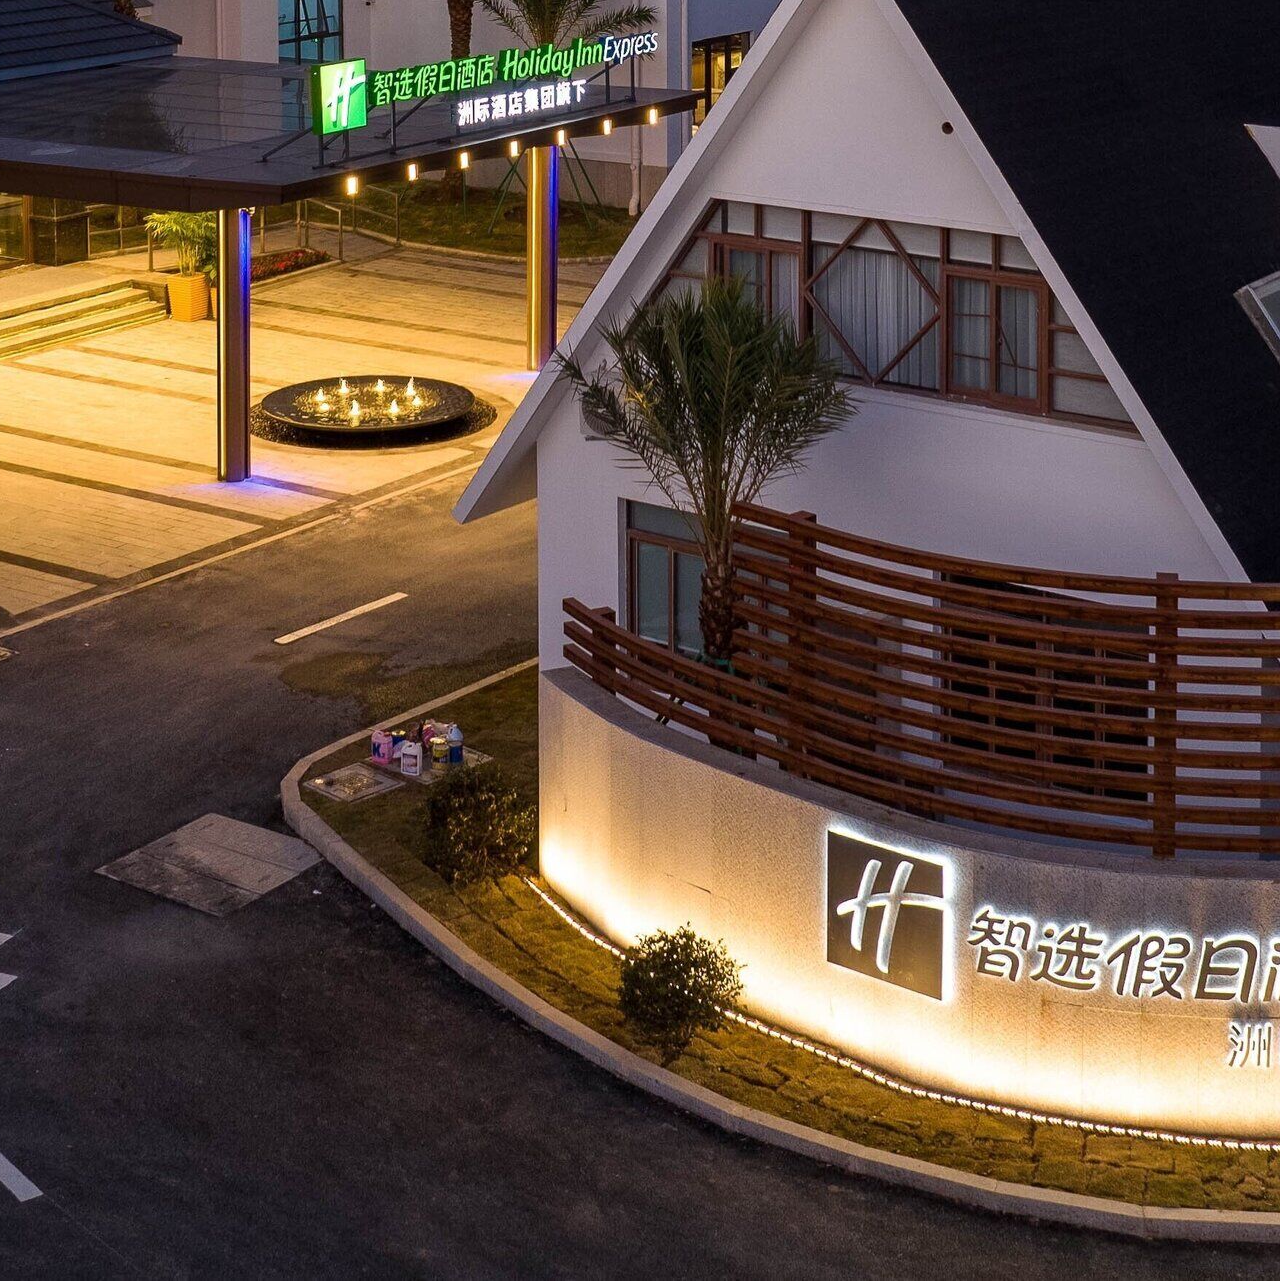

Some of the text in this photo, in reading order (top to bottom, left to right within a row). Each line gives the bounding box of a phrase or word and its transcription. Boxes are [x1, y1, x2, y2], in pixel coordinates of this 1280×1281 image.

[374, 32, 659, 106] 智选假日酒店 Holiday Inn Express
[457, 79, 587, 126] 洲际酒店集团旗下
